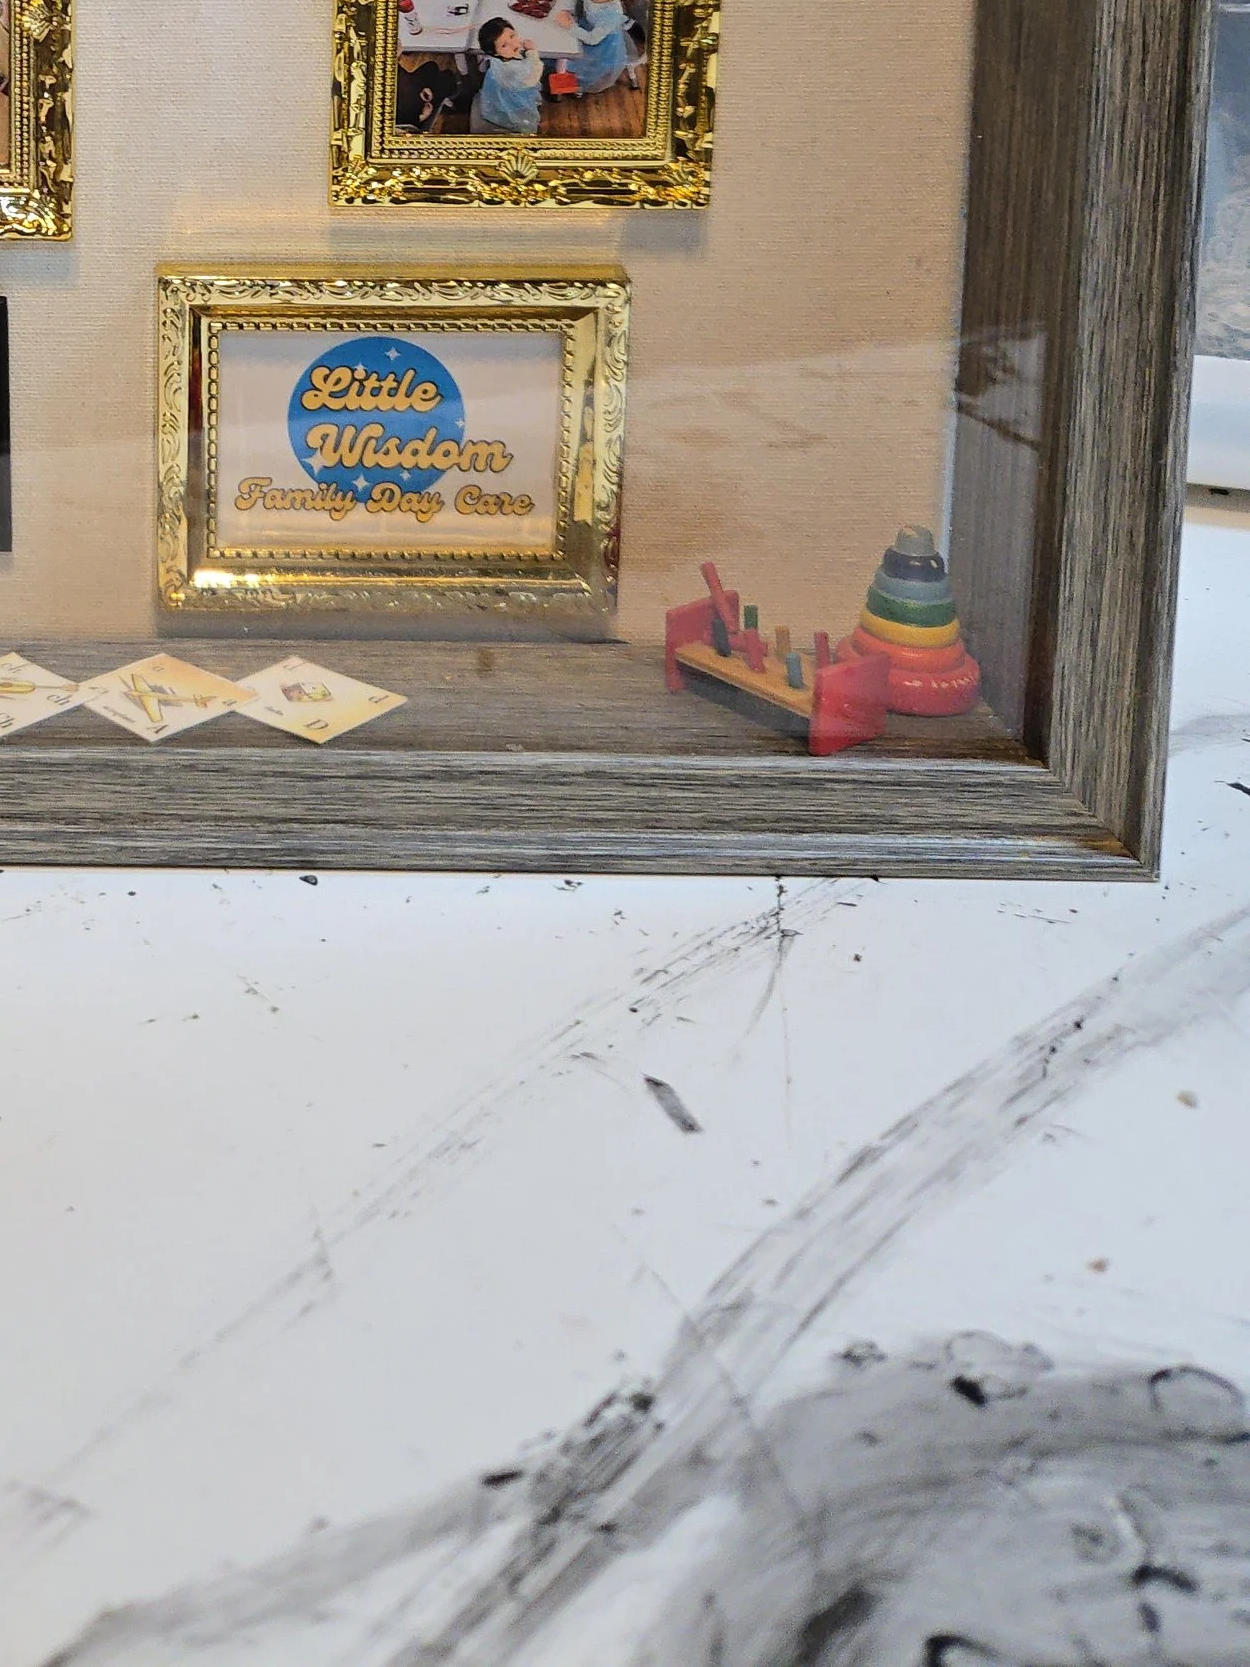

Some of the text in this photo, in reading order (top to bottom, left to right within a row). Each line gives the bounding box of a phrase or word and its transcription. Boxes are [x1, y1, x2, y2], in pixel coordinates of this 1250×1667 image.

[300, 364, 443, 412] Little
[306, 422, 514, 473] Wisdom
[234, 477, 536, 523] Family Day Care
[303, 718, 330, 731] D
